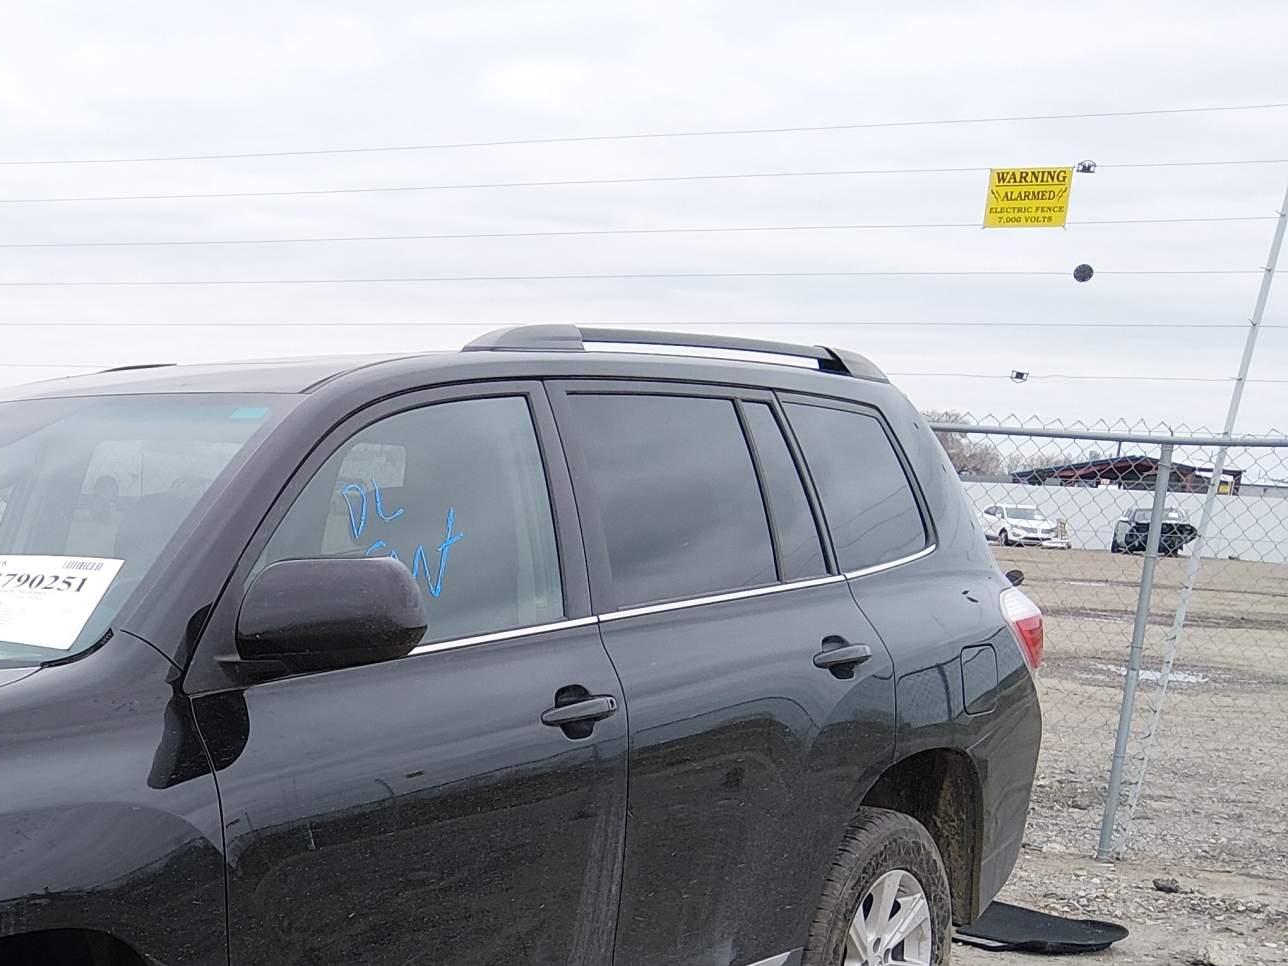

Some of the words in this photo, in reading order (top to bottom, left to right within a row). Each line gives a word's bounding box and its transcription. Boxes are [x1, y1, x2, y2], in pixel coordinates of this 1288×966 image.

[996, 170, 1067, 184] WARNING
[1001, 190, 1056, 202] ALARMED
[989, 206, 1032, 214] ELECTRIC
[997, 216, 1022, 224] 7,000
[1024, 215, 1053, 223] VOLTS
